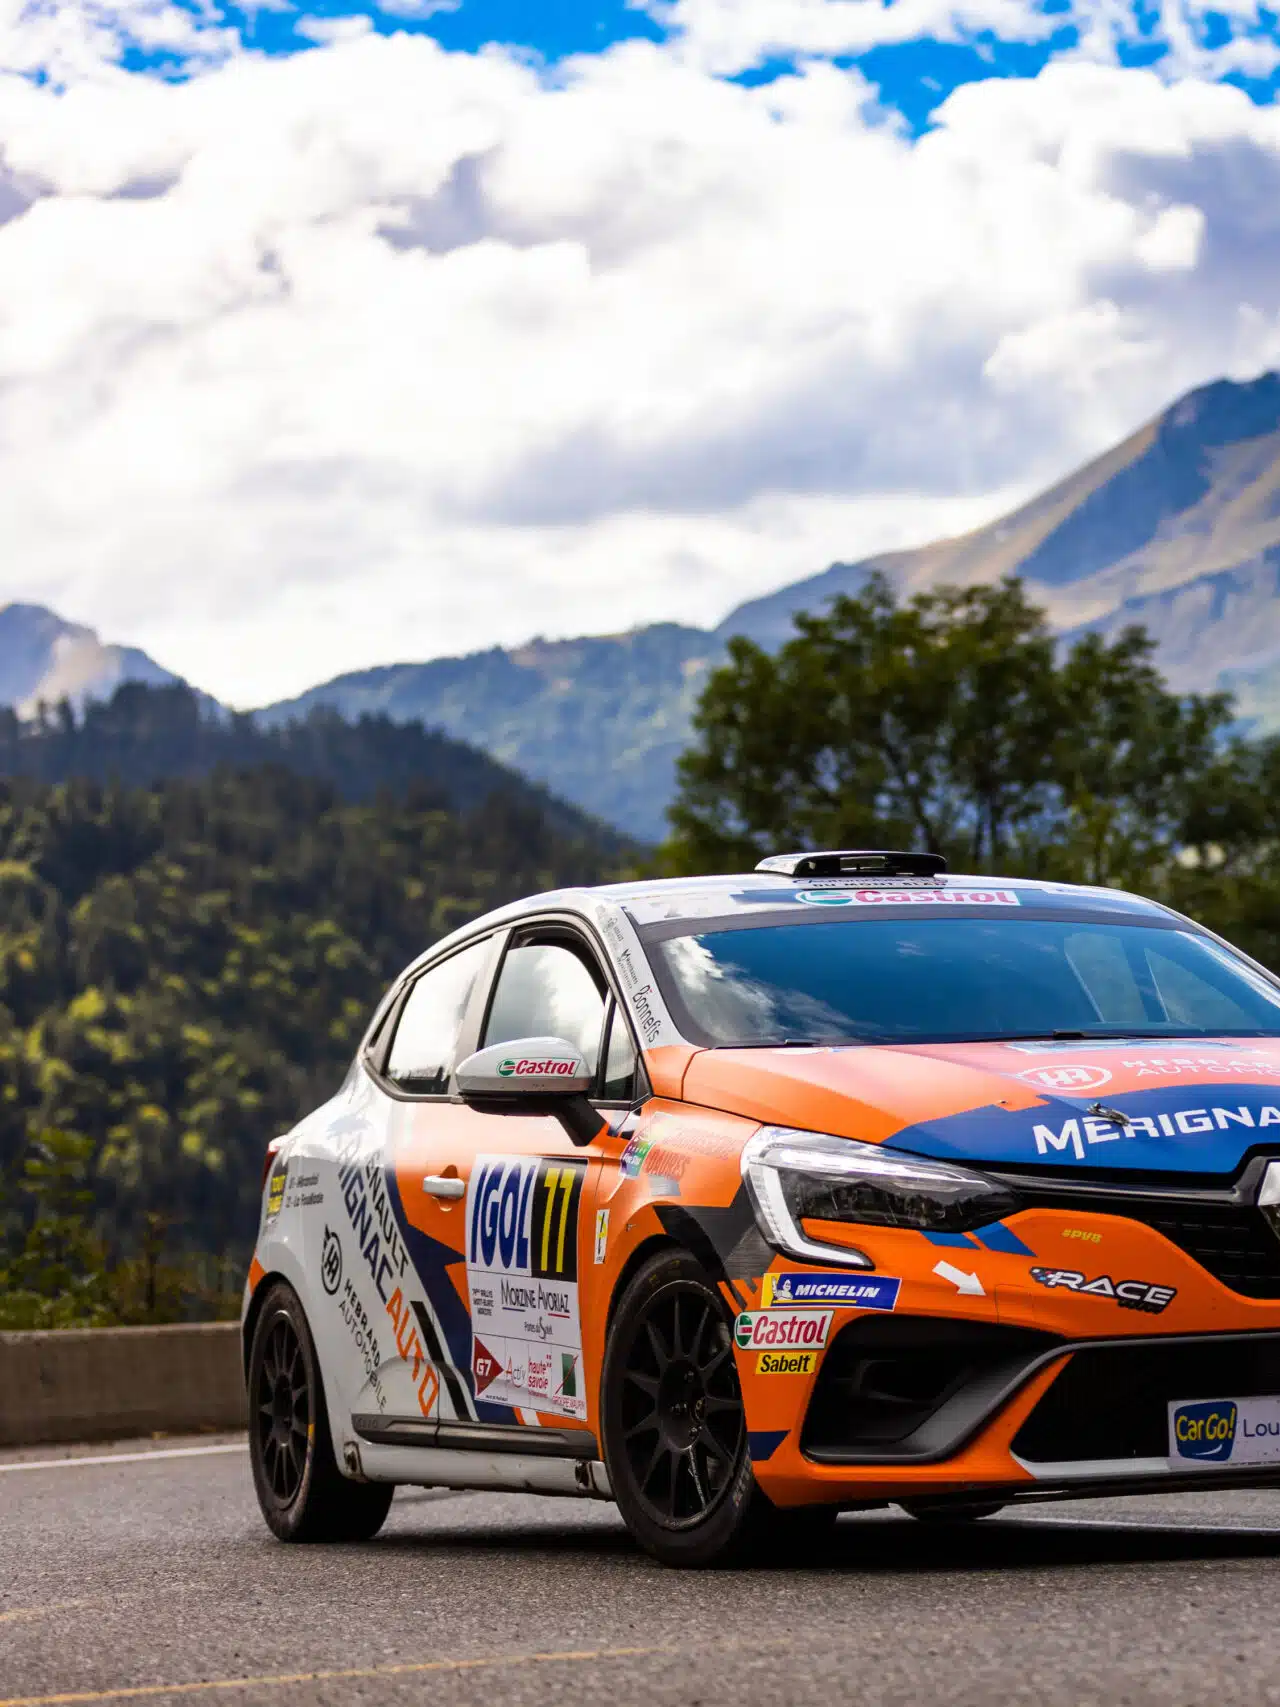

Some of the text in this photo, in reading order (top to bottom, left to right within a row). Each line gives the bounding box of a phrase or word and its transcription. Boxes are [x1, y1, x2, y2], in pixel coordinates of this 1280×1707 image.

[855, 890, 1018, 904] Castrol
[633, 984, 662, 1043] Bonnefis
[516, 1060, 575, 1075] Castrol
[470, 1161, 577, 1273] IGOL 11
[795, 1284, 880, 1298] MICHELIN
[1046, 1271, 1176, 1305] RACE
[344, 1278, 380, 1367] HEBRARD
[753, 1314, 828, 1345] Castrol
[338, 1300, 387, 1413] AUTOMOBILE
[528, 1356, 547, 1374] haute
[760, 1355, 811, 1372] Sabelt
[476, 1358, 492, 1377] G7
[528, 1375, 548, 1389] savoie
